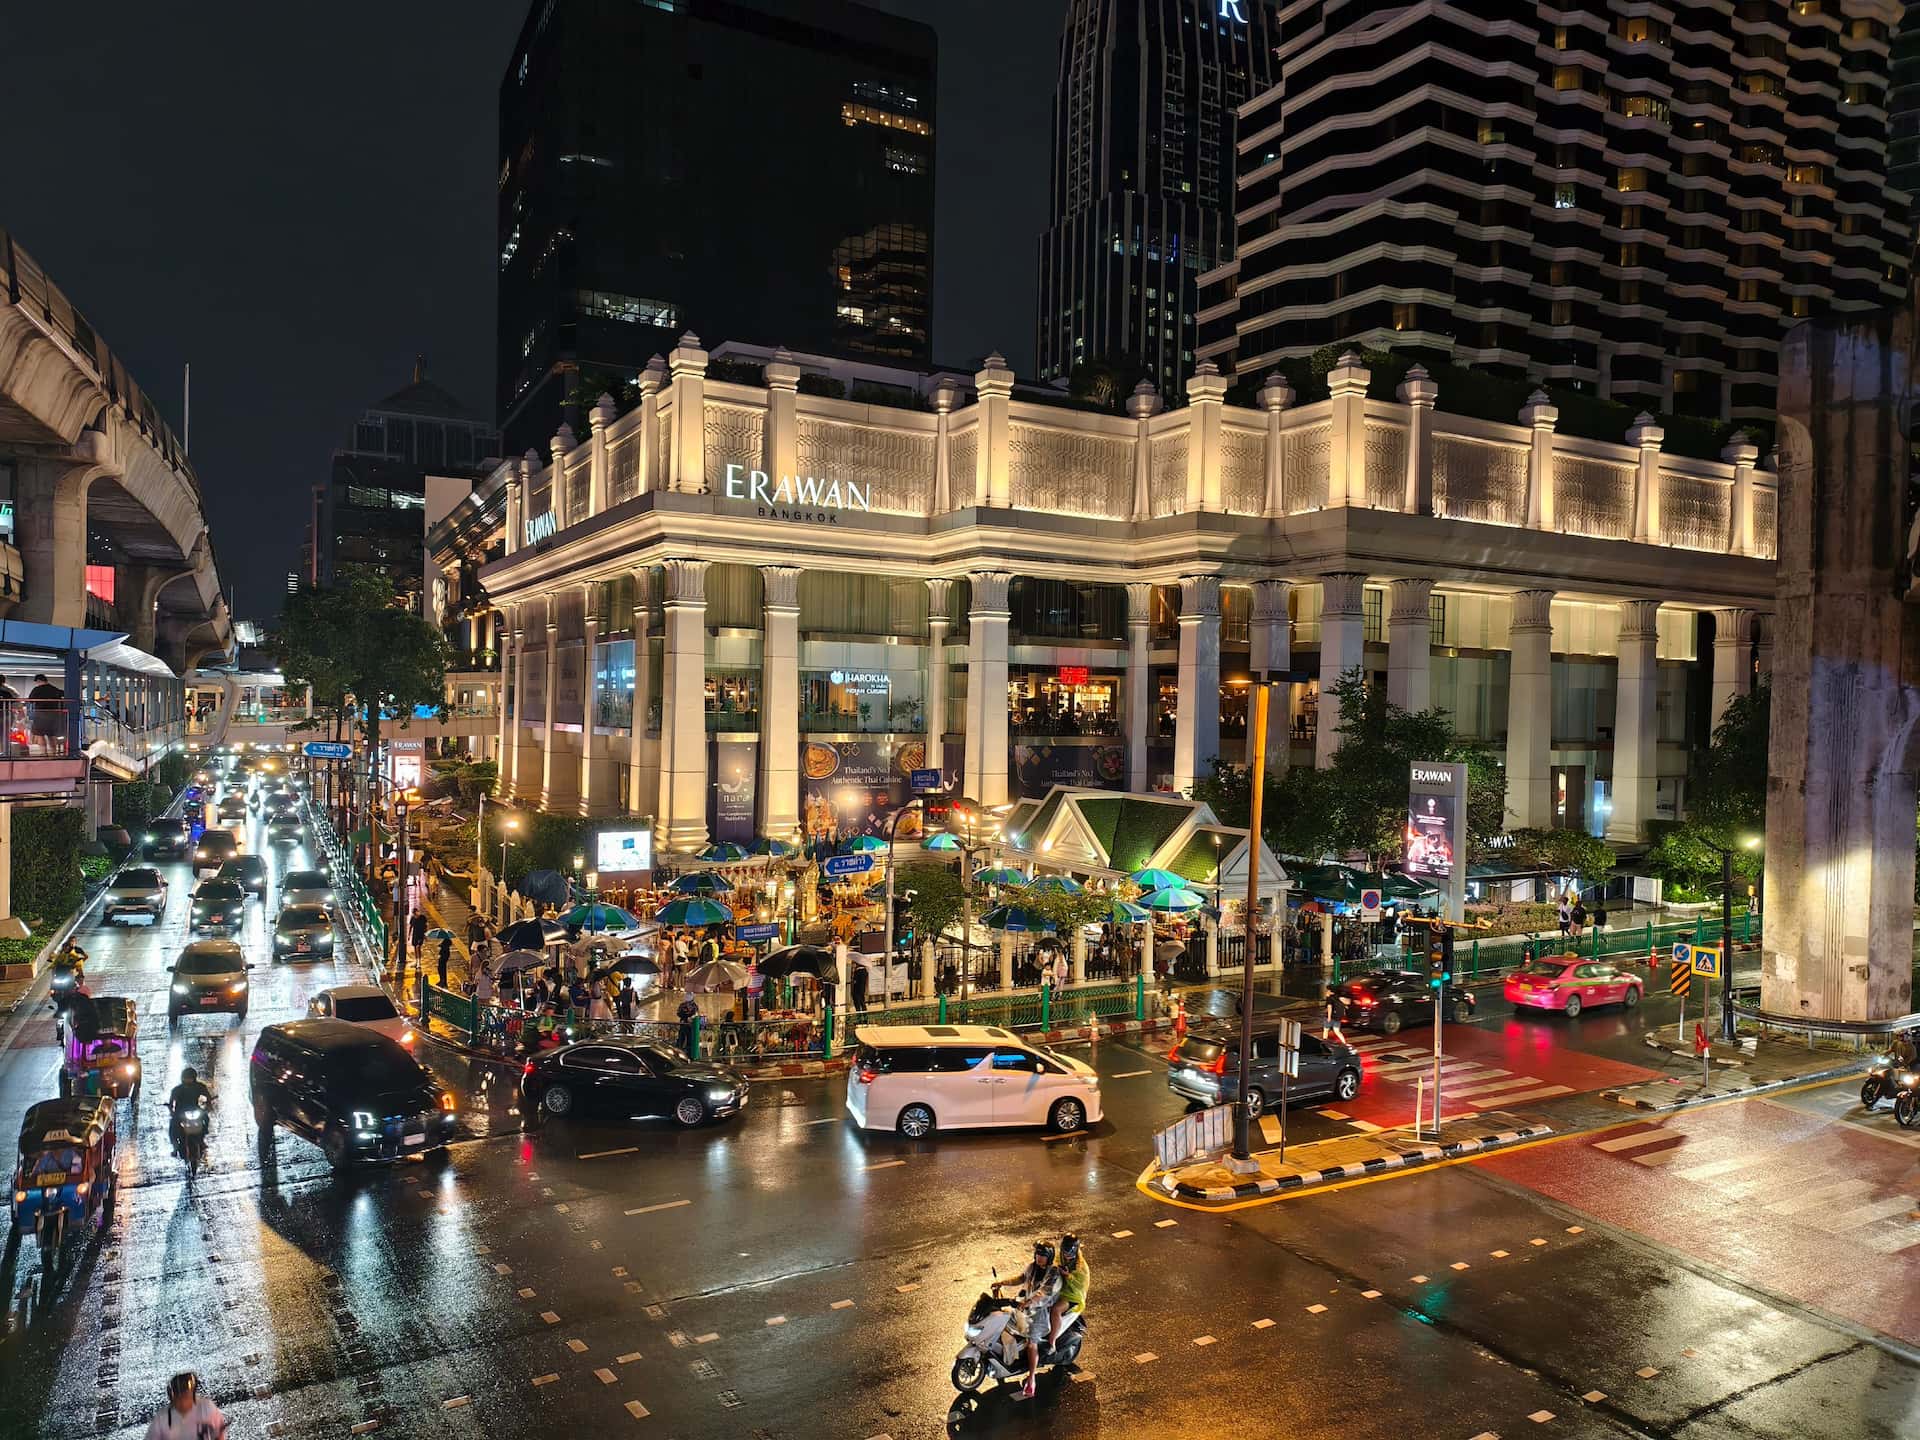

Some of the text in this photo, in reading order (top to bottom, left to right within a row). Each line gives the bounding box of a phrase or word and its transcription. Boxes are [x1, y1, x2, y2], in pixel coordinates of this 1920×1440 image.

[726, 463, 870, 512] ERAWAN
[758, 507, 838, 524] BANGKOK
[525, 510, 557, 546] ERAWAN
[844, 766, 877, 775] Thailand's
[1411, 768, 1452, 783] ERAWAN
[830, 776, 903, 784] Authentic Thai Cuisine
